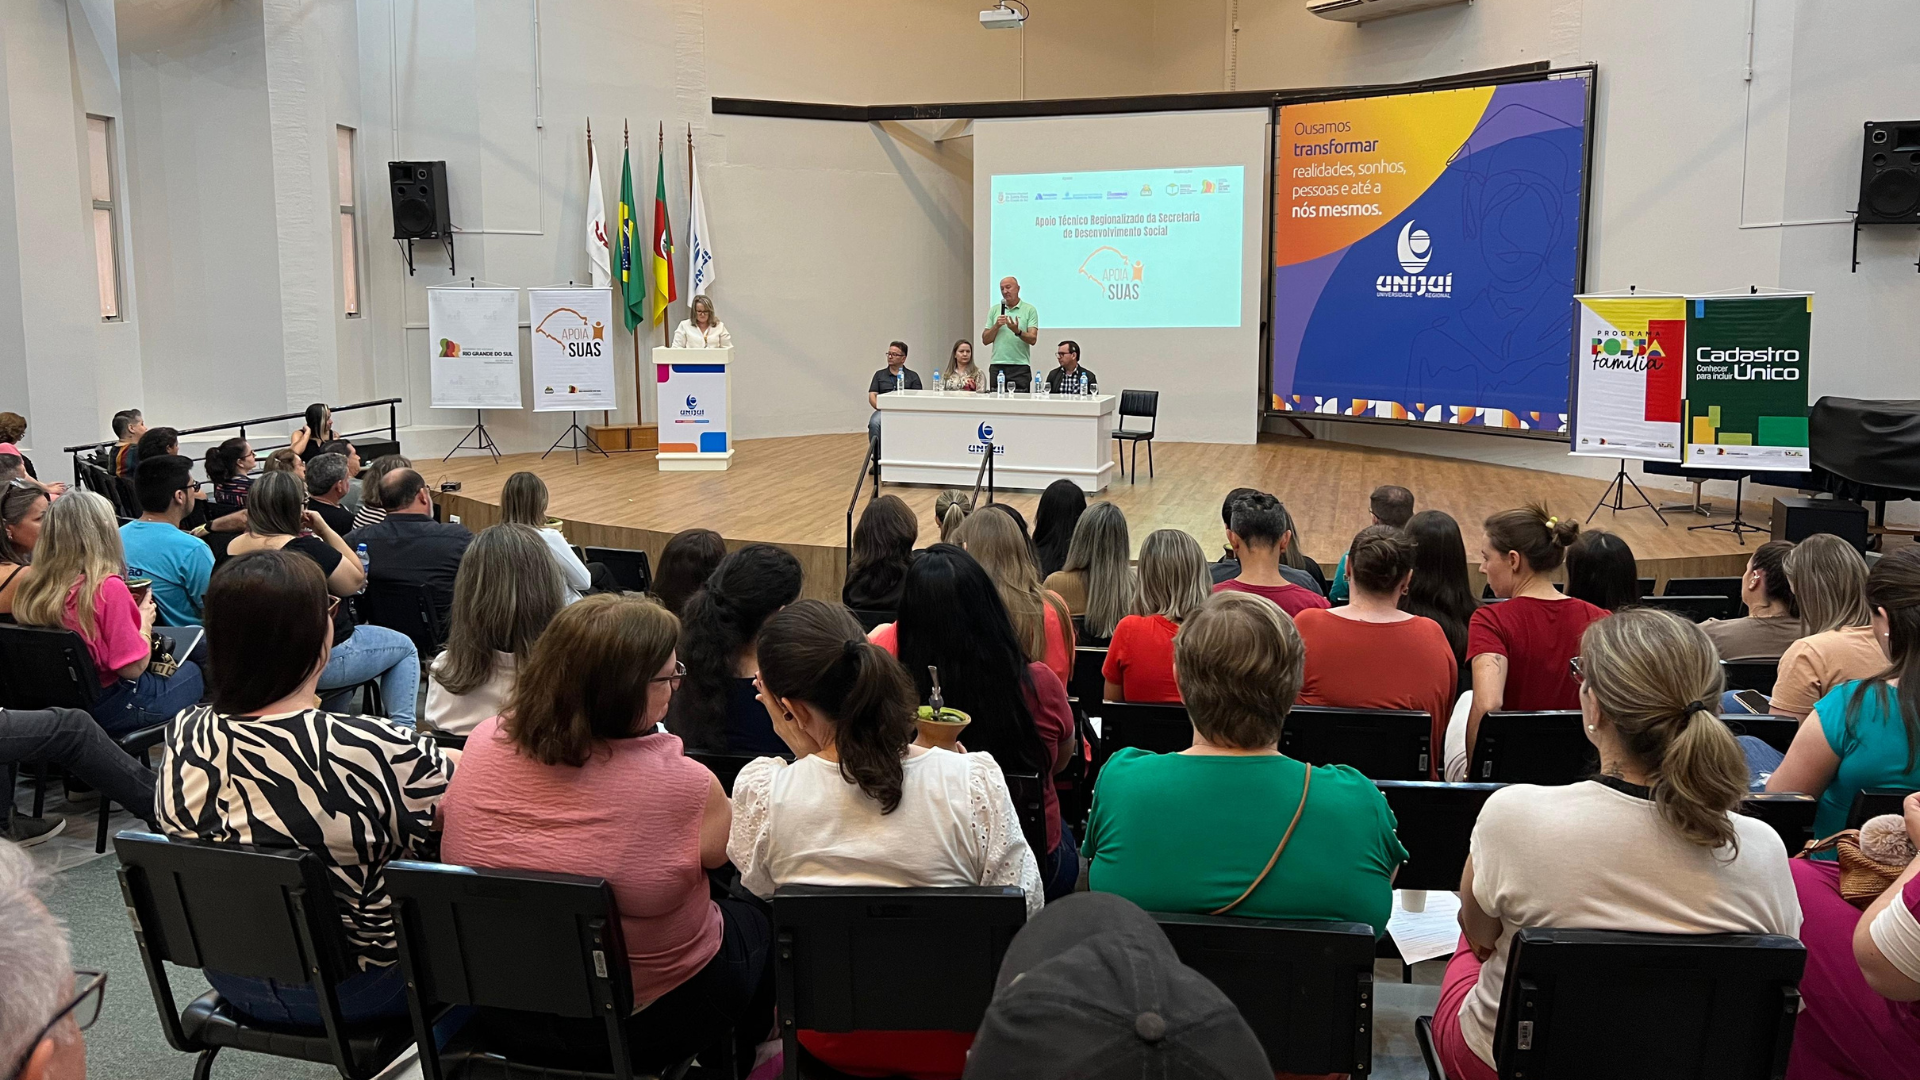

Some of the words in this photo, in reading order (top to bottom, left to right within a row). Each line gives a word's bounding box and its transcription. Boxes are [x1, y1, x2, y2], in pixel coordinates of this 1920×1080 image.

[1294, 121, 1351, 135] Ousamos
[1294, 138, 1379, 157] transformar
[1292, 161, 1356, 178] realidades,
[1358, 158, 1407, 175] sonhos,
[1292, 184, 1339, 200] pessoas
[1341, 184, 1349, 195] e
[1351, 179, 1371, 195] até
[1373, 182, 1382, 194] a
[1291, 201, 1317, 218] nós
[1319, 204, 1383, 217] mesmos.
[1035, 216, 1057, 228] Apoio
[1059, 214, 1089, 226] Técnico
[1090, 212, 1145, 226] Regionalizado
[1146, 213, 1157, 224] da
[1158, 210, 1201, 223] Secretaria
[1063, 228, 1073, 239] de
[1074, 225, 1142, 238] Desenvolvimento
[1143, 225, 1168, 237] Social
[1102, 267, 1129, 281] APOIA
[1108, 283, 1140, 300] SUAS
[562, 328, 589, 340] APOIA
[568, 342, 602, 357] SUAS
[1696, 346, 1800, 362] Cadastro
[1593, 350, 1664, 372] família
[1696, 364, 1729, 373] Conhecer
[1696, 373, 1712, 381] para
[1712, 372, 1734, 380] incluir
[1733, 363, 1800, 380] Único
